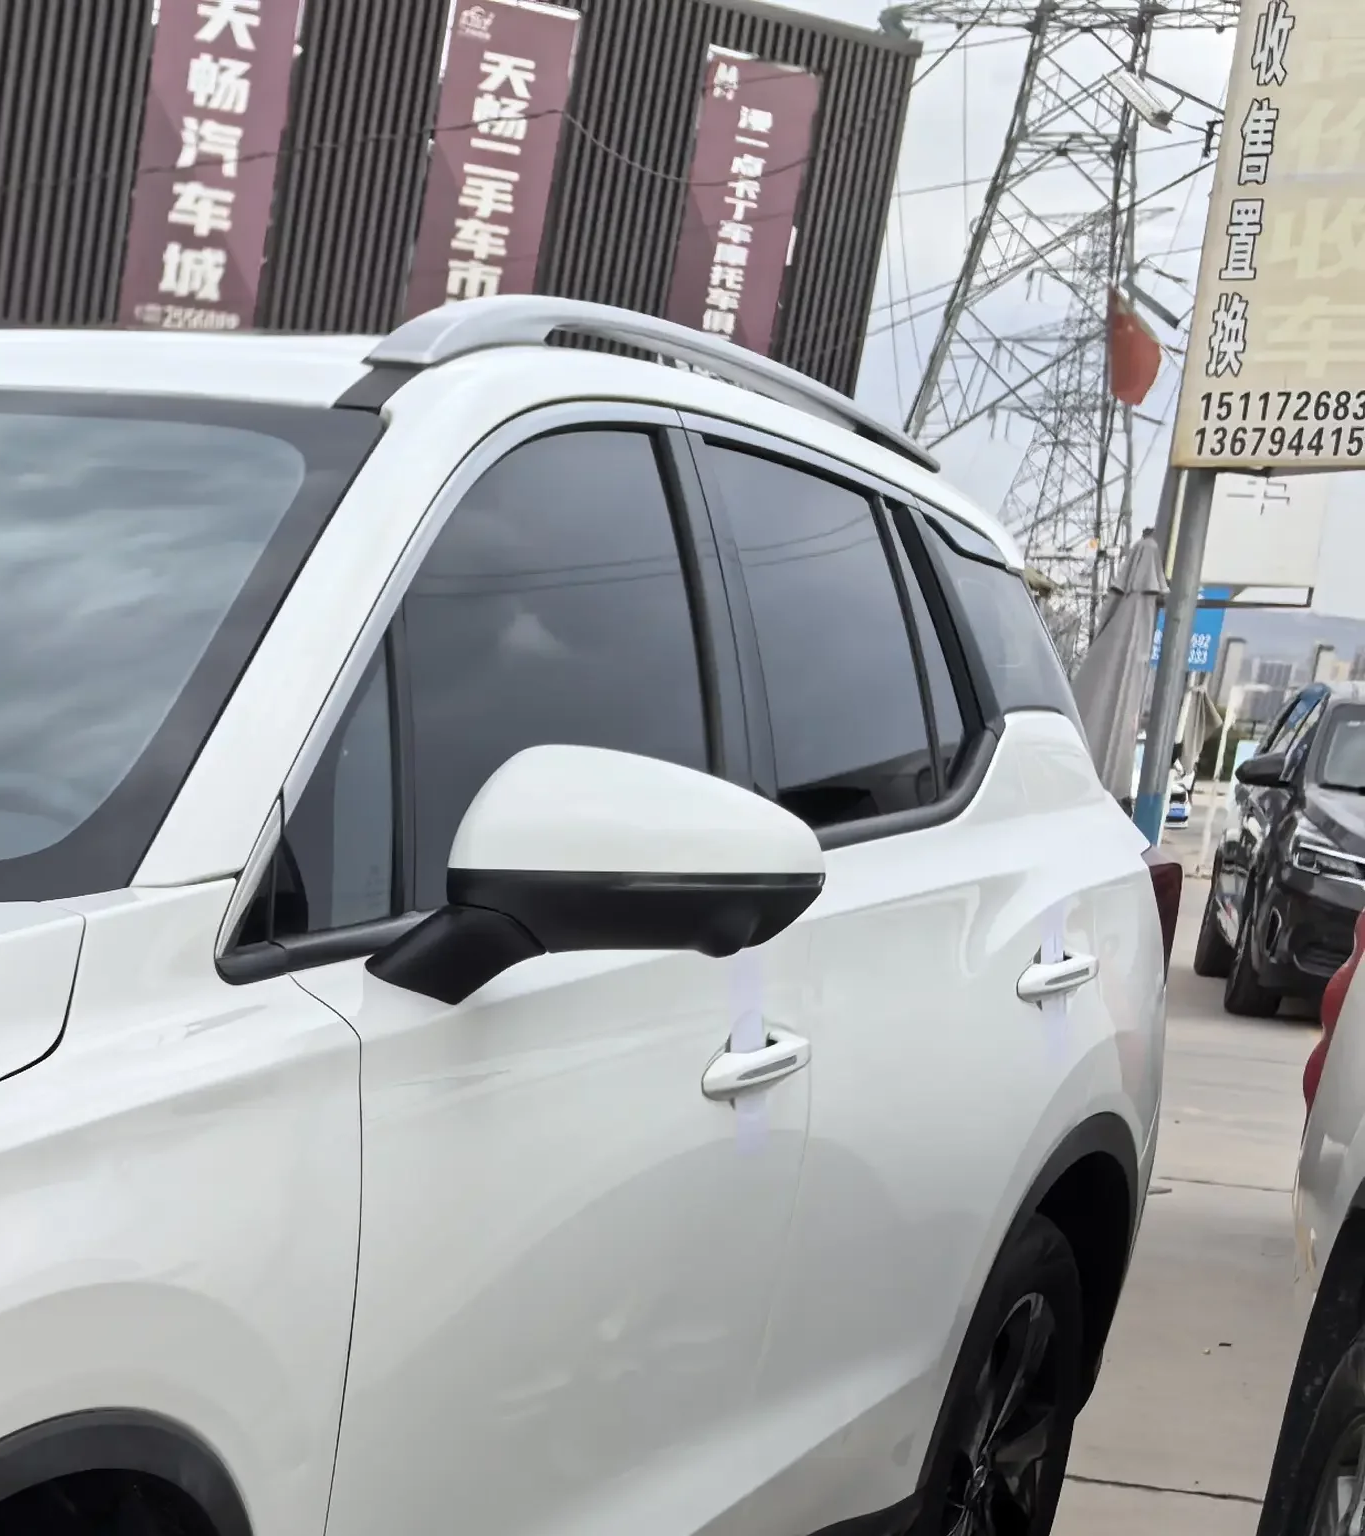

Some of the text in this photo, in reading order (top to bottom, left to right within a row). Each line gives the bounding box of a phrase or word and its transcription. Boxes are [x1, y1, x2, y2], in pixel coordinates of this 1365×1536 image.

[159, 0, 261, 302] 天畅汽车城
[445, 51, 536, 303] 天畅二手车市
[1206, 0, 1295, 378] 收售置换
[1194, 425, 1365, 457] 136794415
[1200, 388, 1365, 421] 151172683
